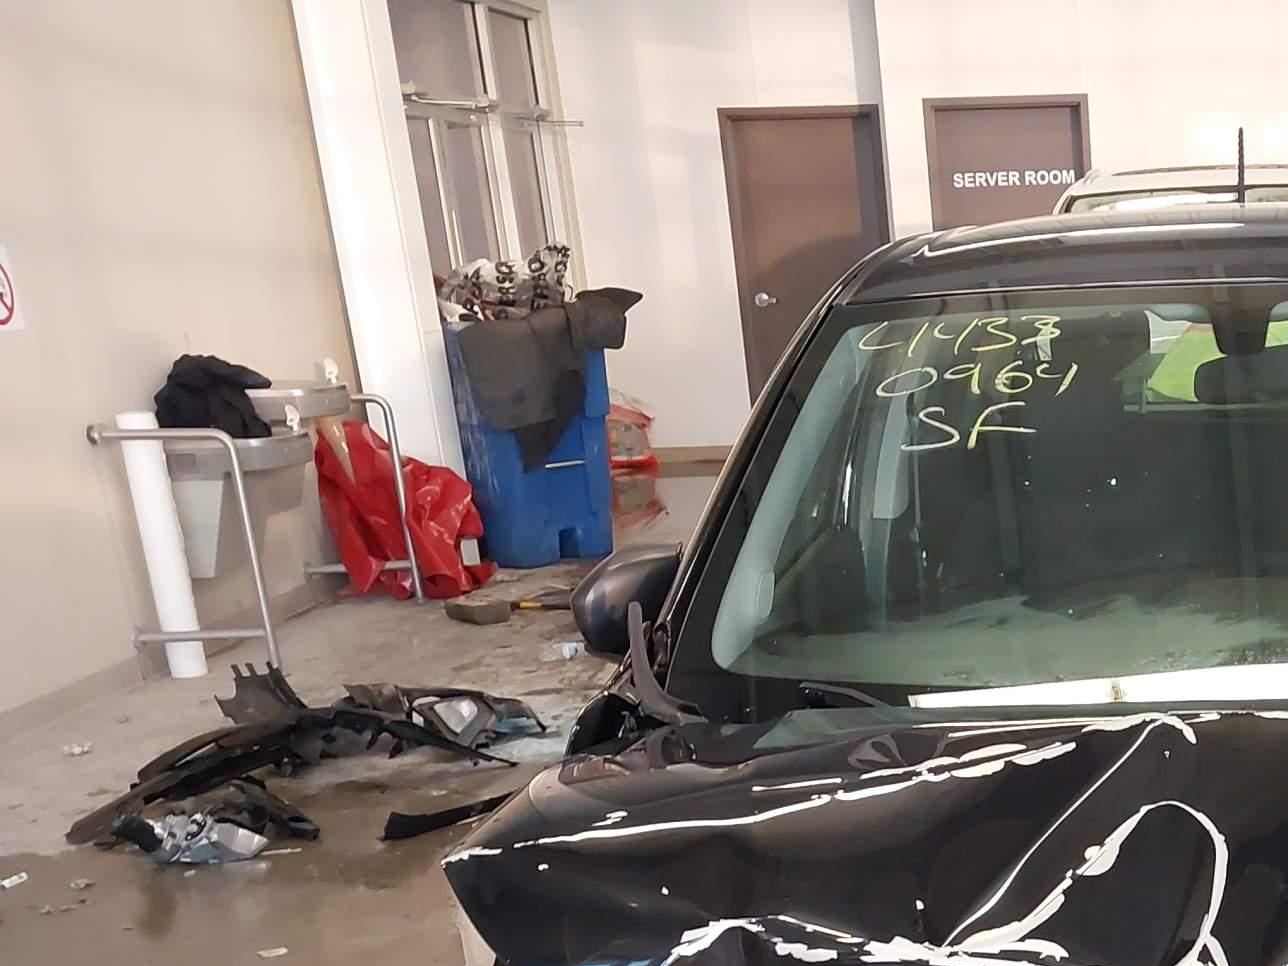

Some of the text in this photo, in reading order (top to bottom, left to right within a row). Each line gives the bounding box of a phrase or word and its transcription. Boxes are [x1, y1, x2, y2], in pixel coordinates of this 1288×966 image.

[952, 169, 1076, 188] SERVER ROOM
[874, 359, 1079, 398] 0964
[900, 401, 1038, 451] SF
